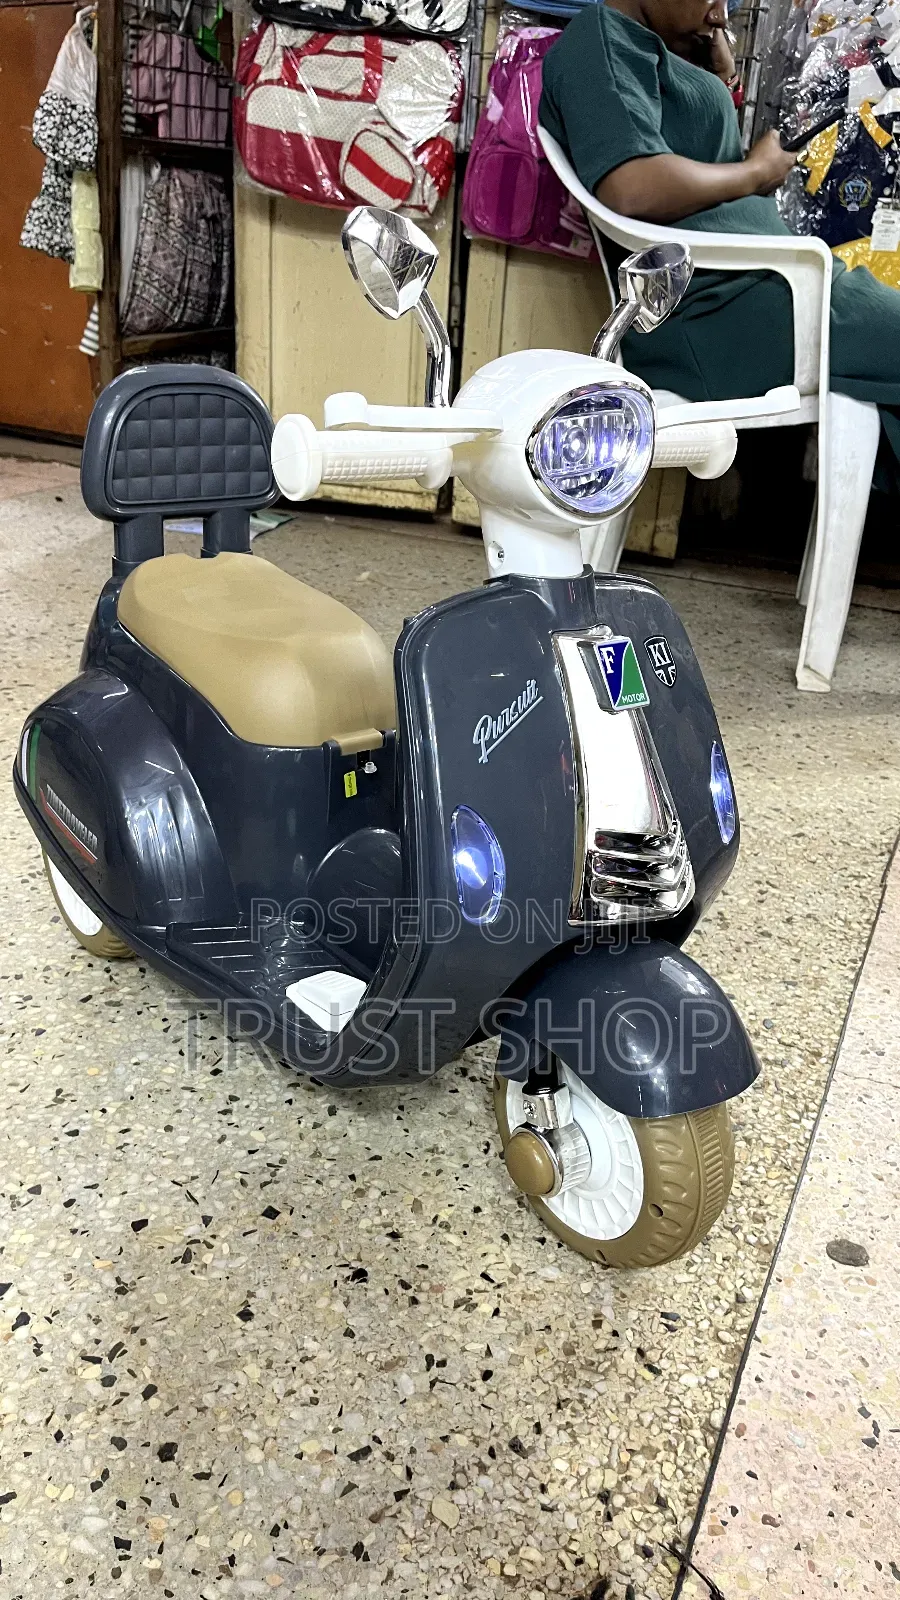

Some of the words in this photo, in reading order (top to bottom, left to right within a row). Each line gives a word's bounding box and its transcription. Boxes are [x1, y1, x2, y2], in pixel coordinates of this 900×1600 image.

[600, 646, 617, 674] F
[648, 643, 669, 667] KI
[622, 692, 646, 704] MOTOR
[472, 679, 543, 763] Pursuit
